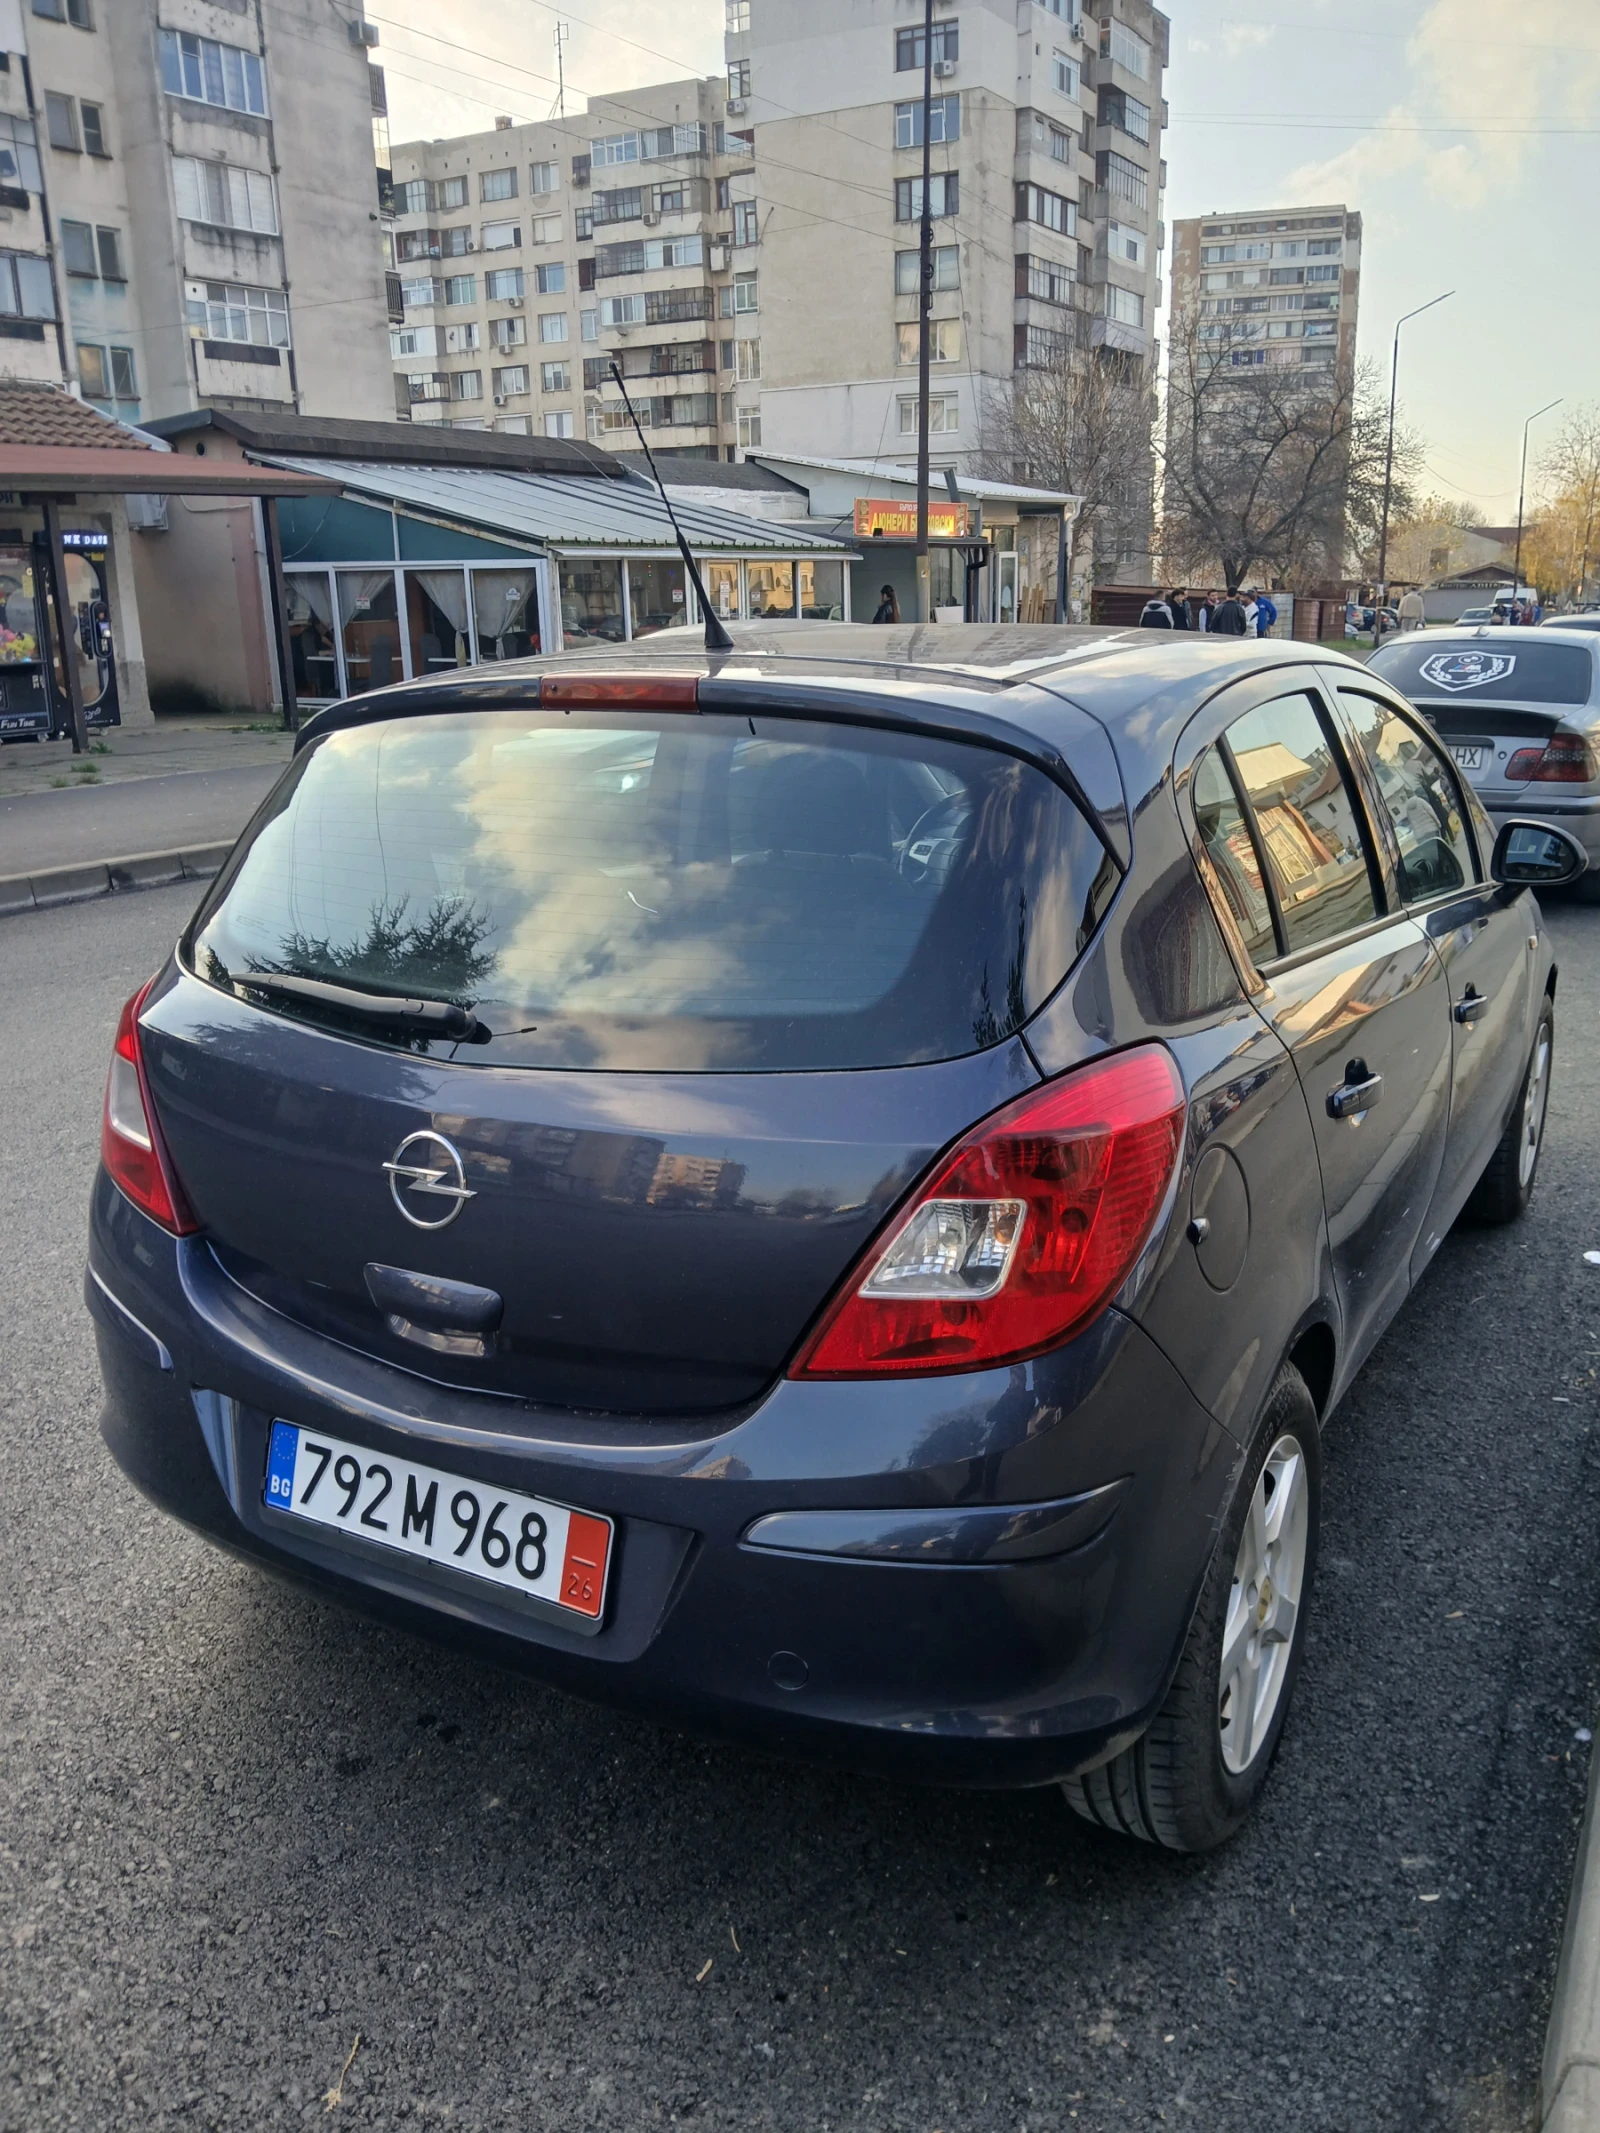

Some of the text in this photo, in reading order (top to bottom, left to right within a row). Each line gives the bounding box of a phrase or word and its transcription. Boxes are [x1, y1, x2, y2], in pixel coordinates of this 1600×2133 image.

[871, 512, 908, 532] ДЮНЕРИ
[1, 717, 36, 729] FUN TIME
[1455, 747, 1479, 766] HX
[270, 1474, 291, 1498] BG
[567, 1572, 594, 1601] 26
